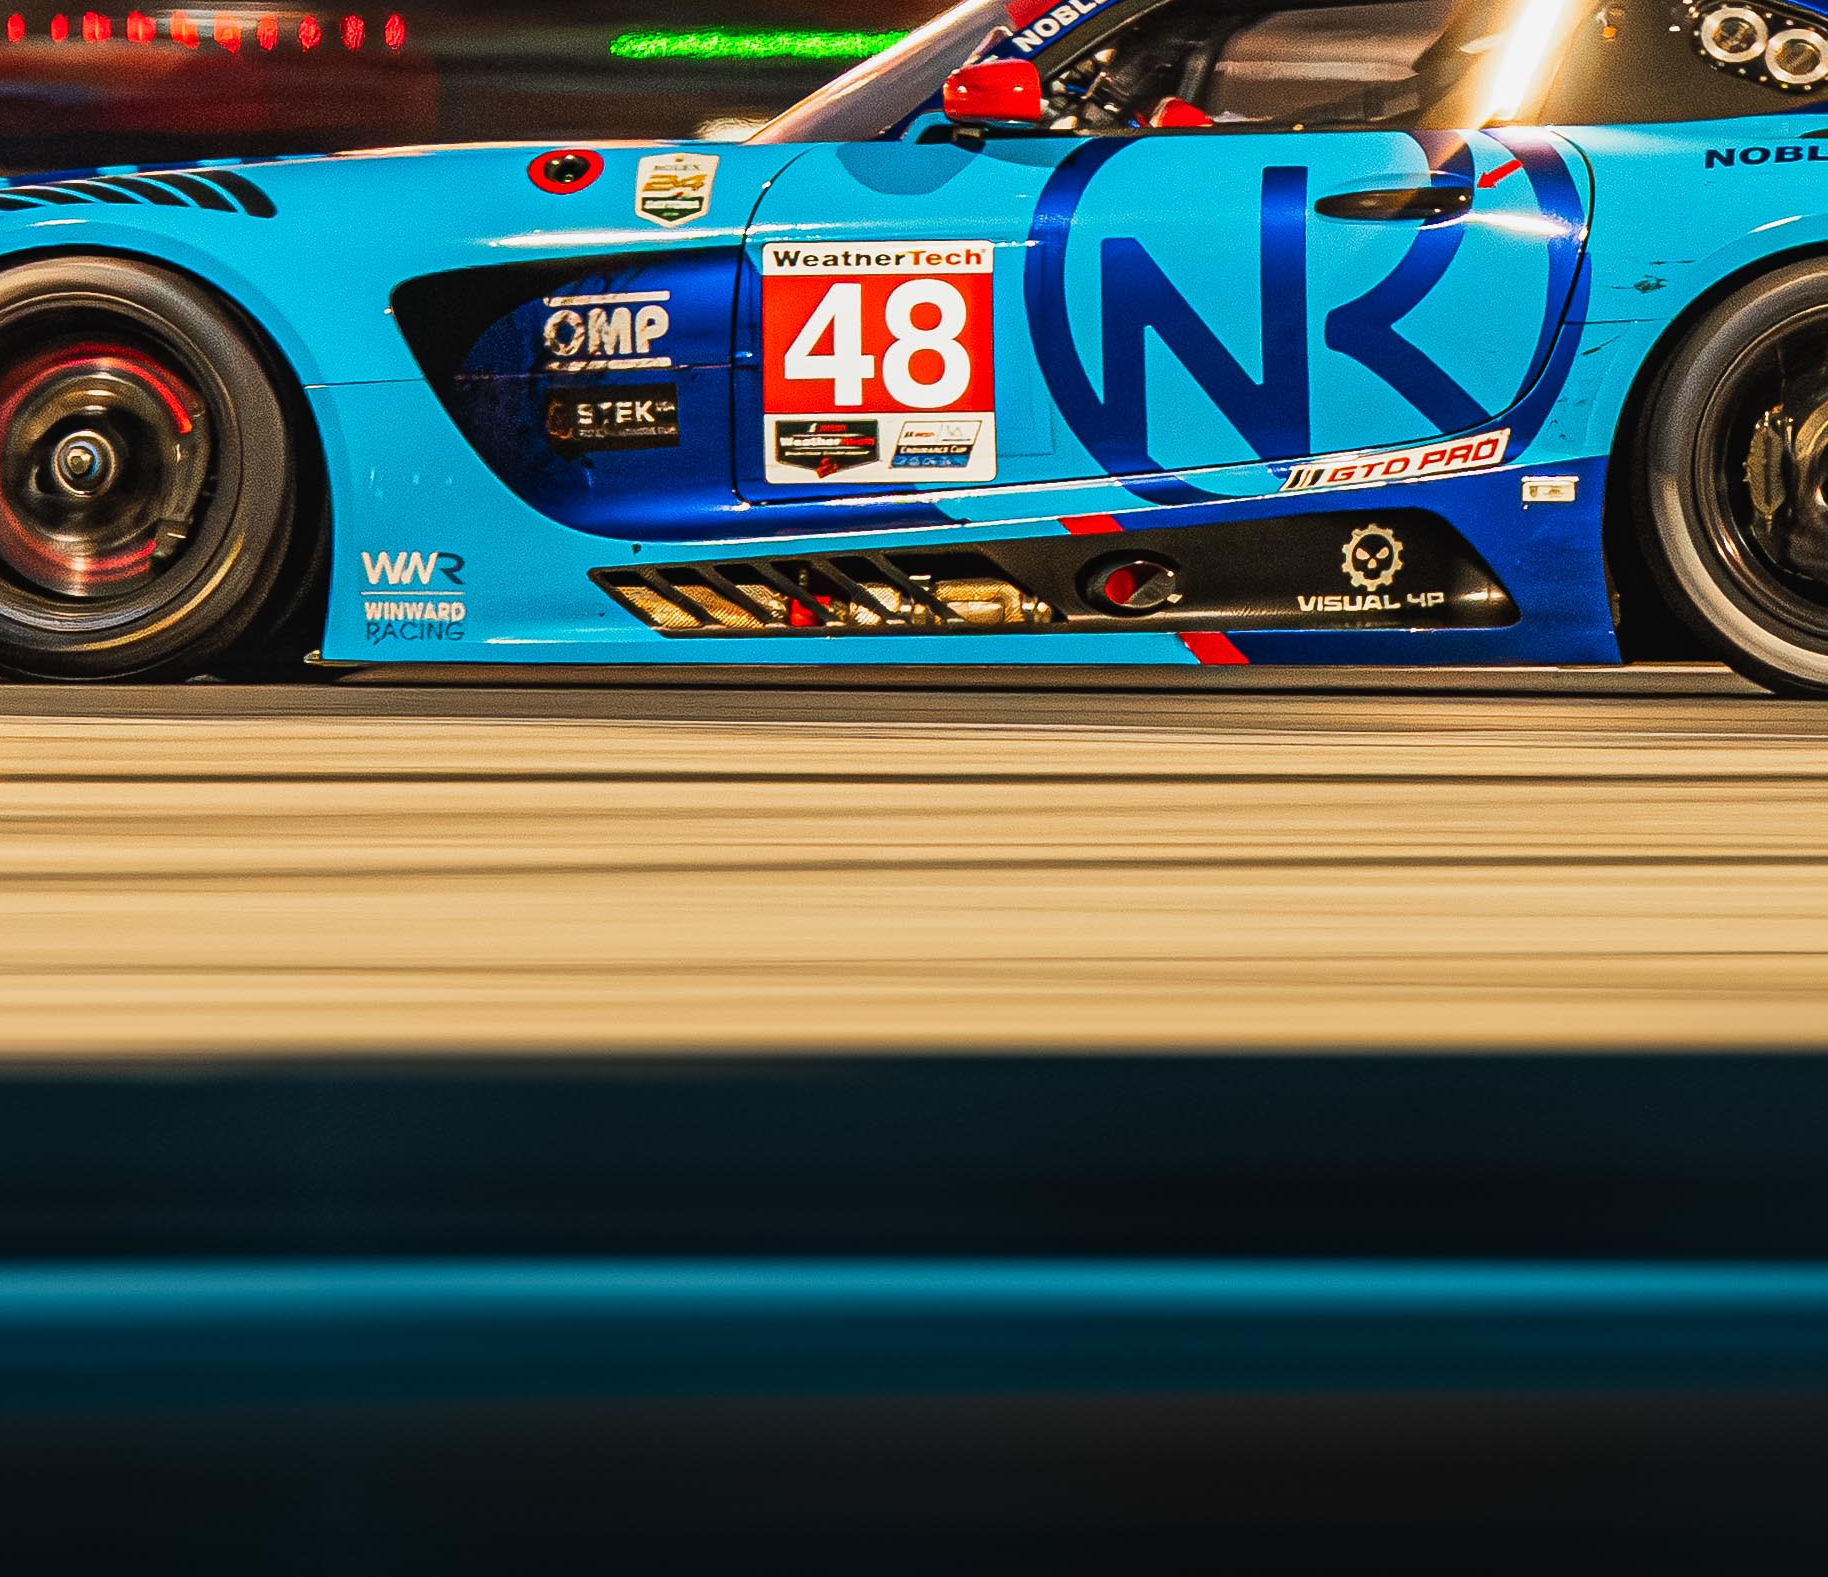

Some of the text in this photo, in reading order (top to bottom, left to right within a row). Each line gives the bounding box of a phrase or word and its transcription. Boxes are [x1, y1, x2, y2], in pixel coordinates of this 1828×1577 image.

[543, 304, 670, 356] OMP
[784, 278, 971, 409] 48
[1327, 437, 1500, 483] GTD PRO
[364, 601, 467, 621] WINWARD
[1297, 594, 1401, 612] VISUAL
